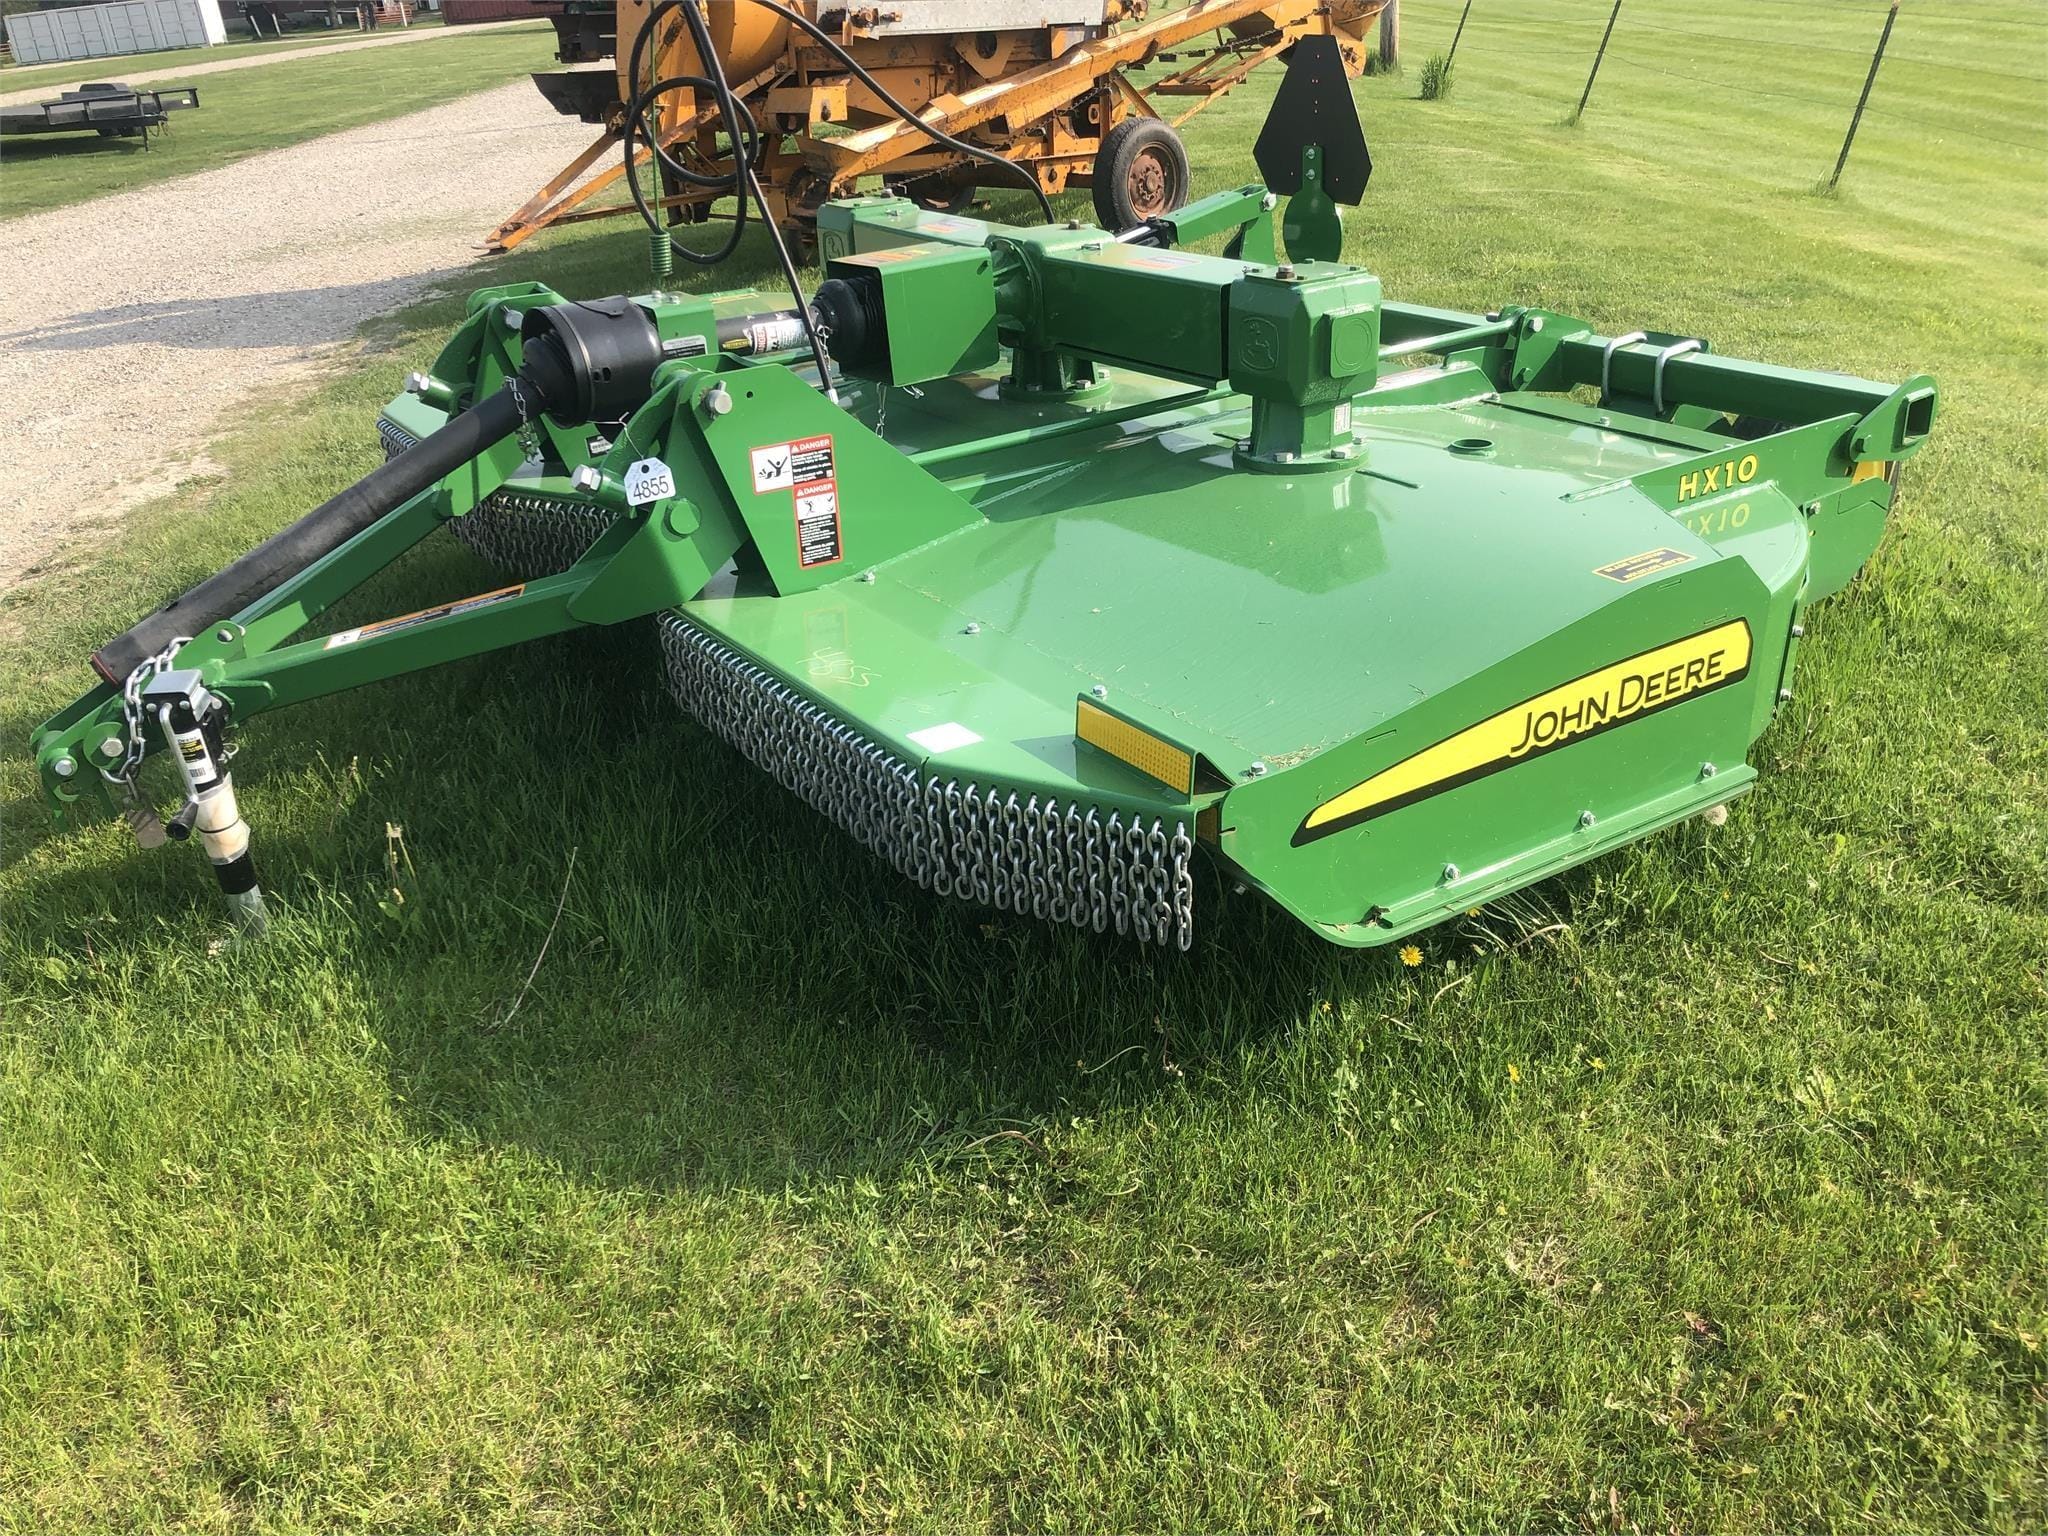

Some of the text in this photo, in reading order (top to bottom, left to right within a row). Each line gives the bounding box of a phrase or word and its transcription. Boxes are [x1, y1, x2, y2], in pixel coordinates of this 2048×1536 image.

[800, 439, 830, 450] DANGER
[633, 475, 669, 500] 4855
[804, 483, 833, 495] DANGER
[1678, 454, 1758, 503] HX10
[1510, 649, 1725, 753] JOHN DEERE
